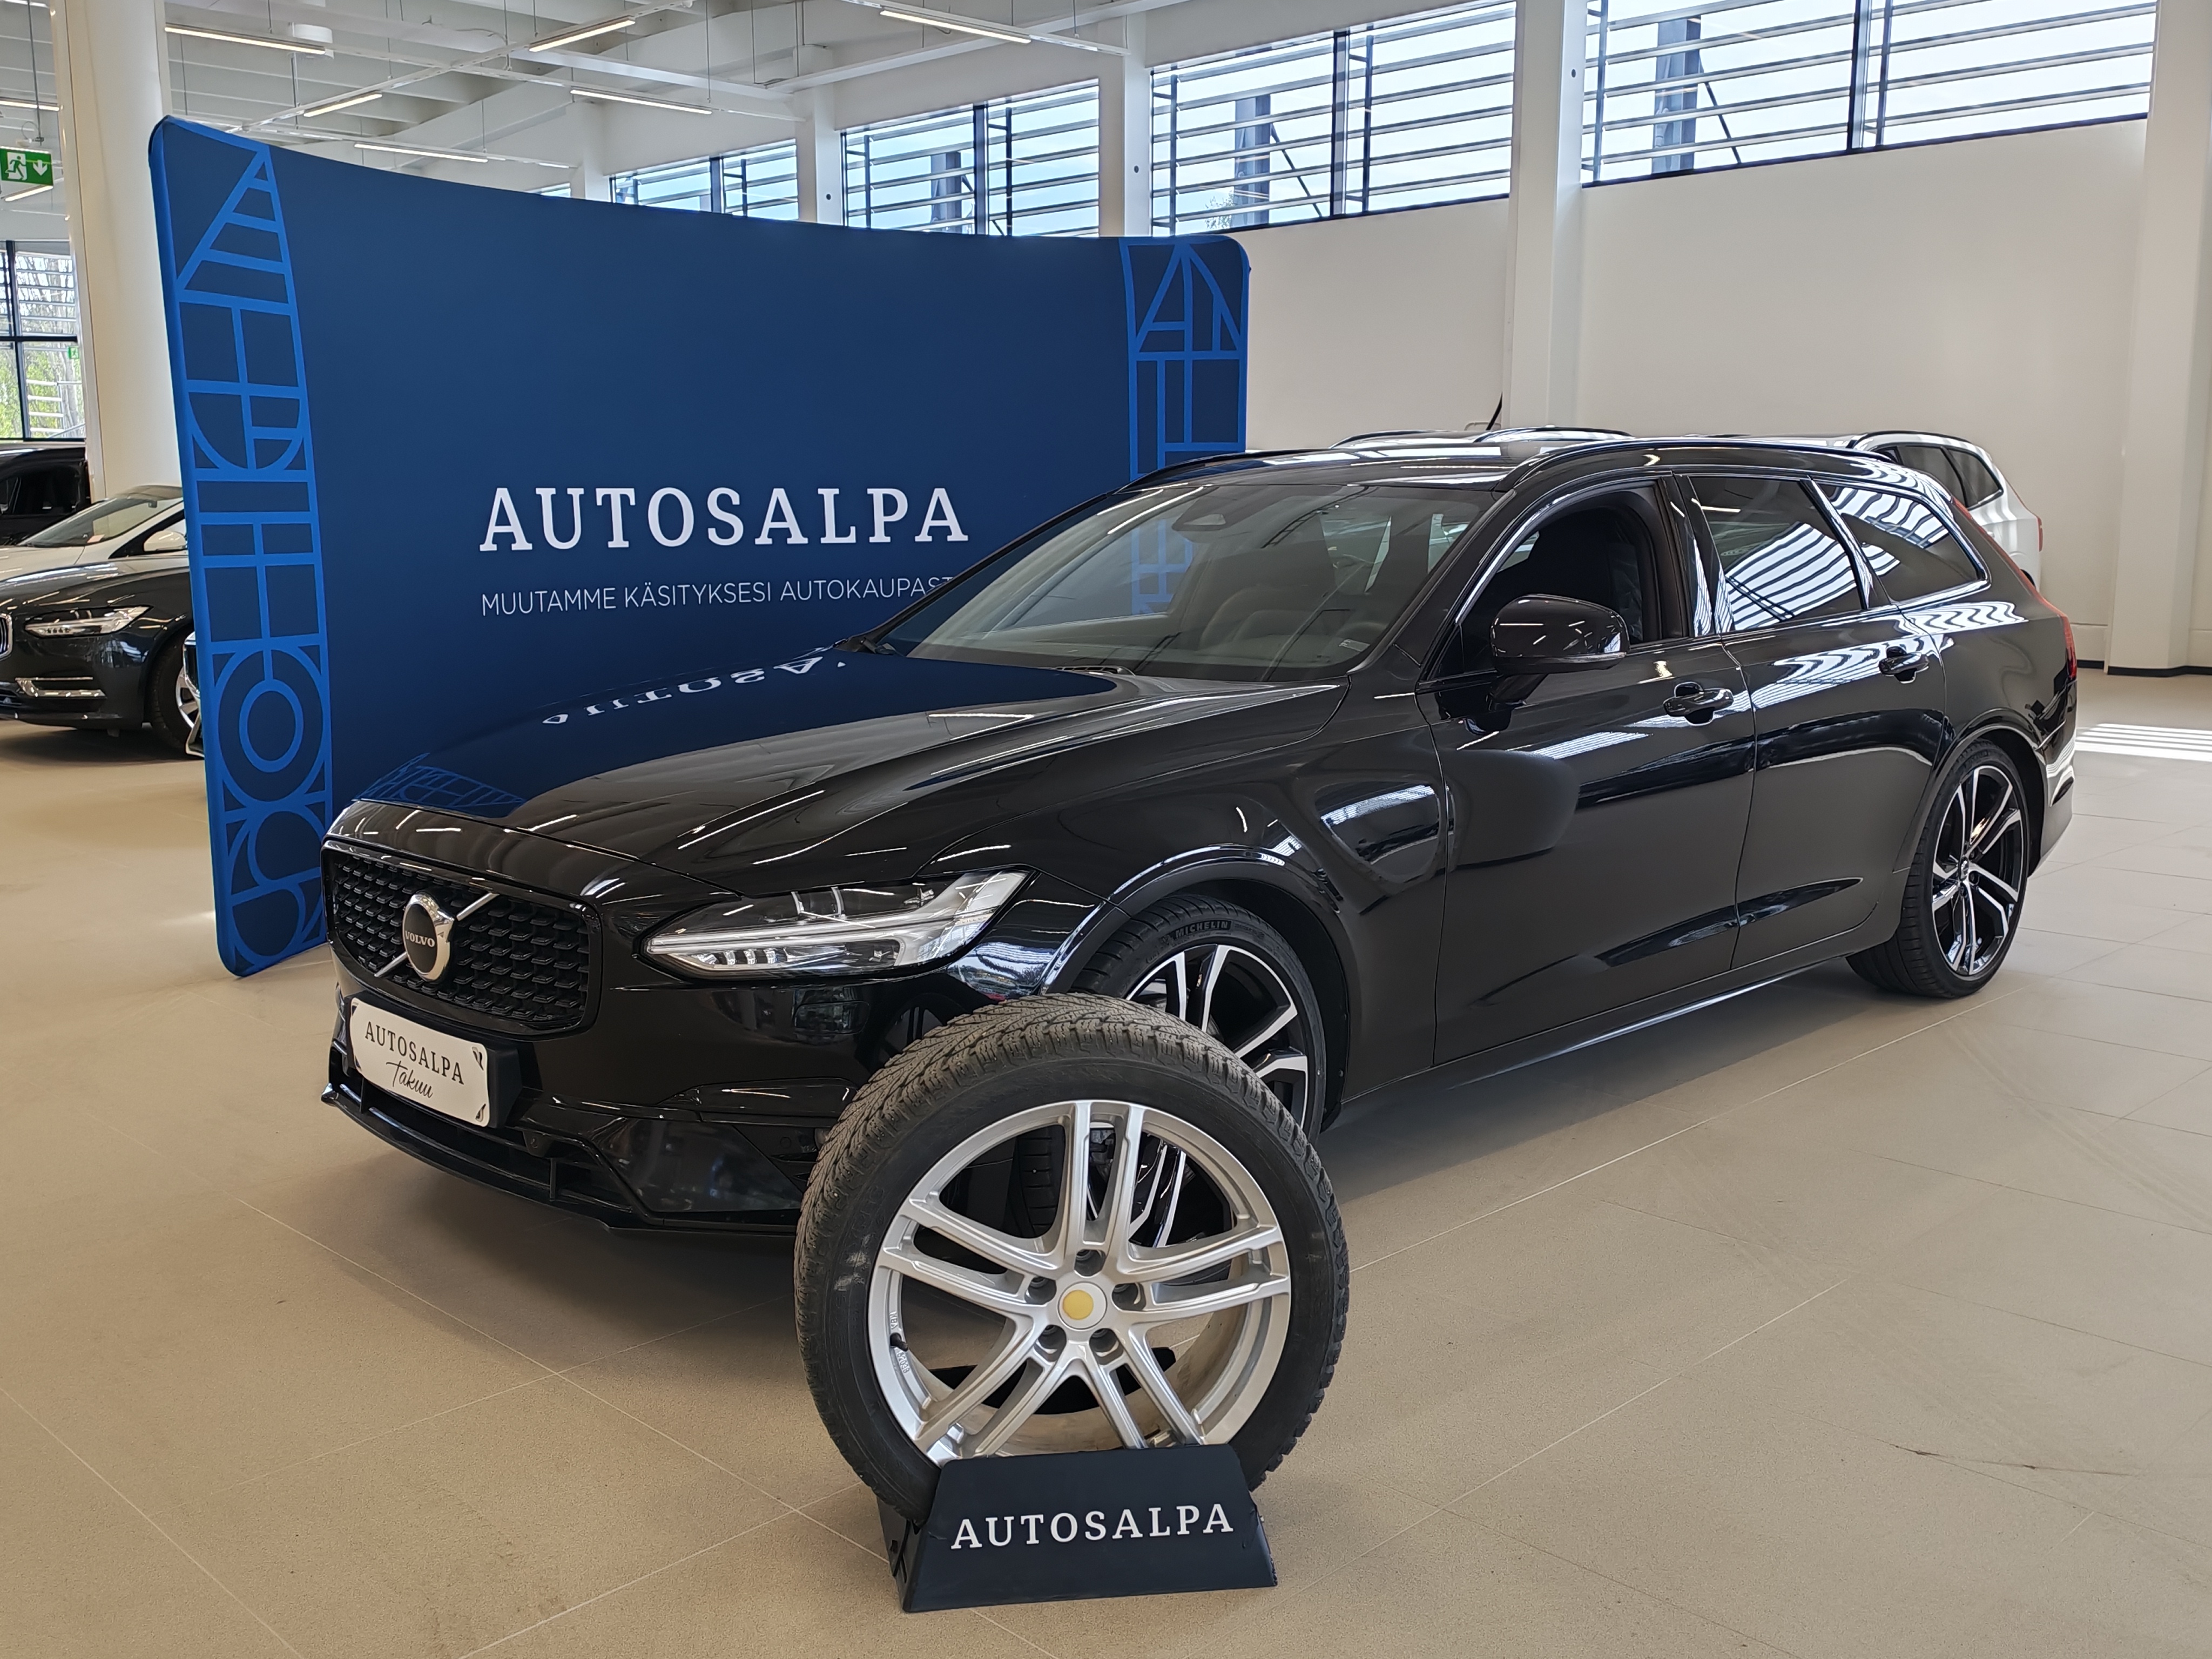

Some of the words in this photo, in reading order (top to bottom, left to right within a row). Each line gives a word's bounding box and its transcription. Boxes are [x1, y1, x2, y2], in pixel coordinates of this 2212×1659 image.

[479, 487, 968, 552] AUTOSALPA
[482, 587, 617, 617] MUUTAMME
[624, 581, 771, 608] KÄSITYKSESI
[780, 576, 954, 601] AUTOKAUPAS
[404, 930, 435, 948] VOLVO
[1175, 921, 1229, 939] MICHELIN
[365, 1021, 464, 1085] AUTOSALPA
[386, 1060, 434, 1098] Takuu
[950, 1503, 1233, 1549] AUTOSALPA
